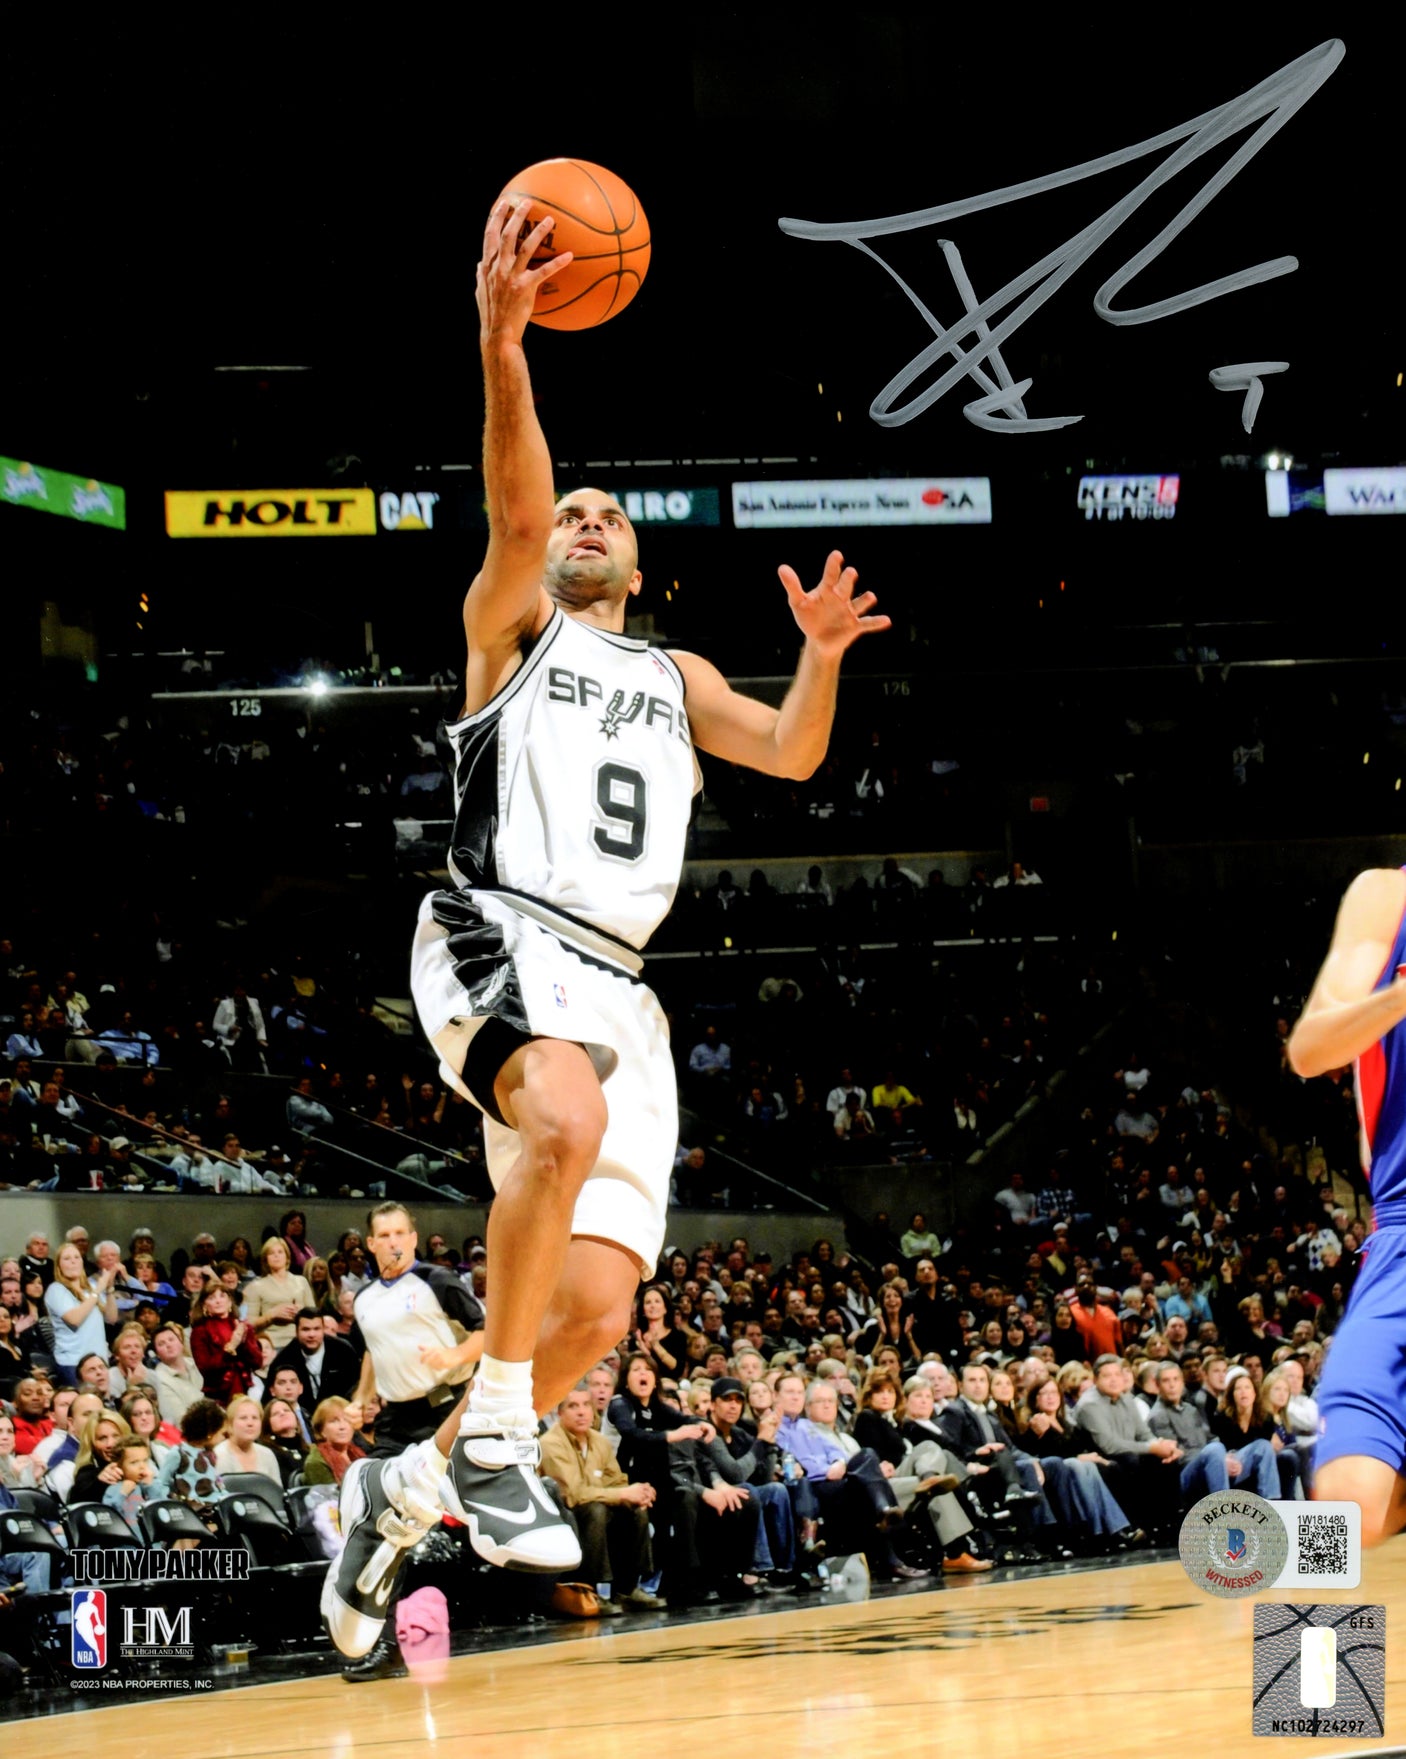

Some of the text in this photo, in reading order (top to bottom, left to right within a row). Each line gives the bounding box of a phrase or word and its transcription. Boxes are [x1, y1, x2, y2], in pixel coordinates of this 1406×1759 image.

[1081, 484, 1157, 500] KENS
[203, 499, 356, 526] HOLT
[379, 491, 435, 531] CAT
[611, 490, 692, 521] ERO
[738, 500, 765, 512] San
[768, 496, 817, 512] Antonio
[229, 698, 262, 717] 125
[546, 666, 691, 750] SPURS
[590, 759, 649, 867] 9
[1202, 1502, 1269, 1525] BECKETT
[1297, 1514, 1346, 1525] 1W181480
[1205, 1567, 1264, 1589] WITNESSED
[1349, 1616, 1375, 1629] GFS
[1271, 1719, 1365, 1734] NC102724297
